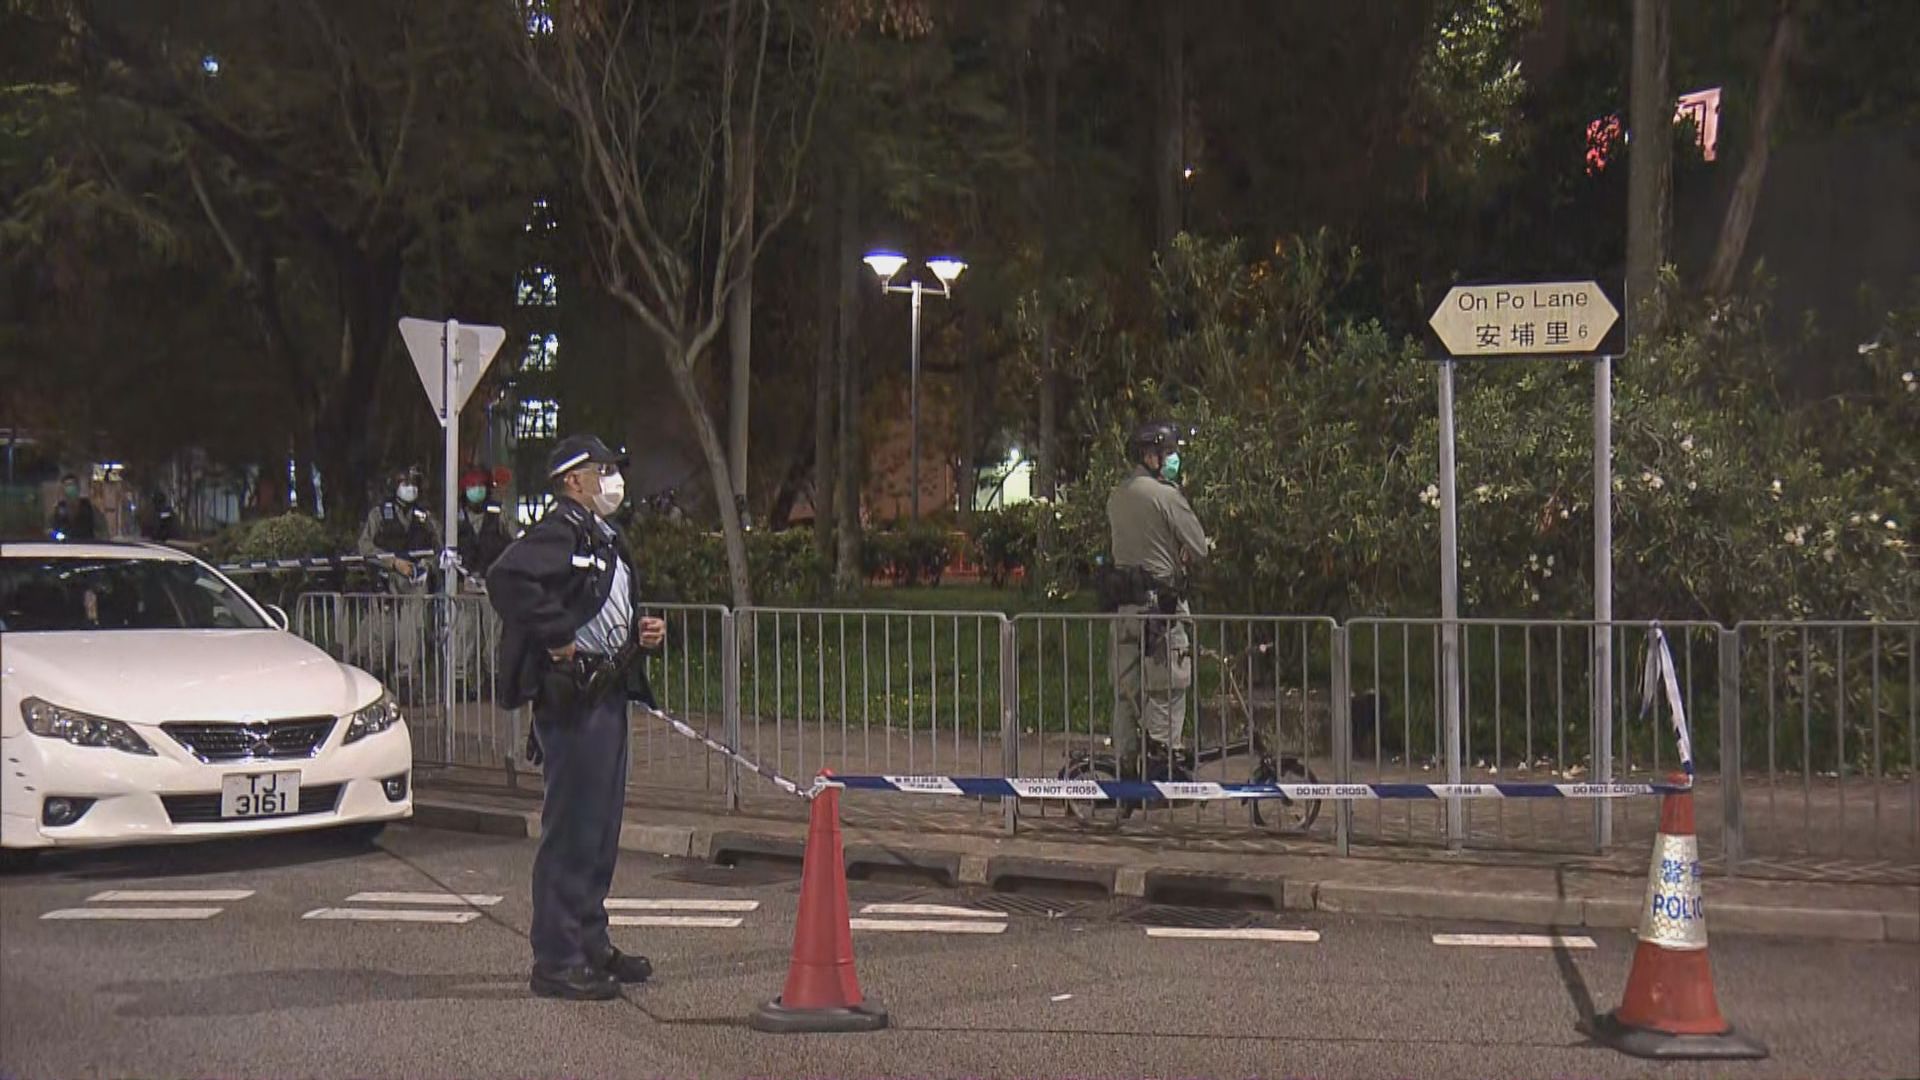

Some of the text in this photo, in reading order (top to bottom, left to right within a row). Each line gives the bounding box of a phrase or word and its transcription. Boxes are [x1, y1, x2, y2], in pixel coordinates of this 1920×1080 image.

[1458, 290, 1588, 311] On Po Lane
[1476, 321, 1588, 347] 安埔里 6
[246, 773, 277, 794] TJ
[1028, 785, 1098, 795] DO NOT CROSS
[1296, 786, 1367, 795] DO NOT CROSS
[236, 792, 286, 815] 3161
